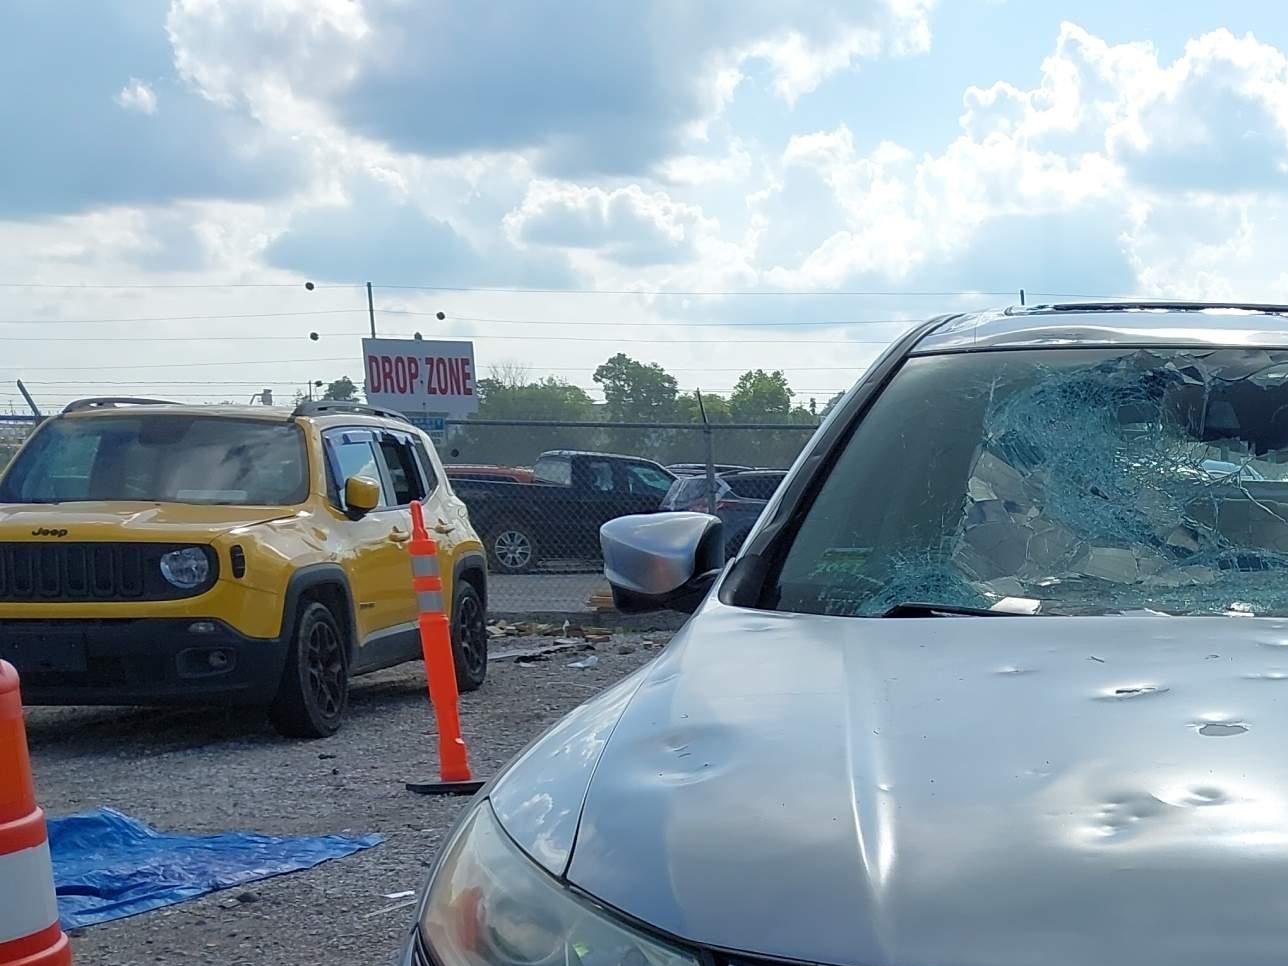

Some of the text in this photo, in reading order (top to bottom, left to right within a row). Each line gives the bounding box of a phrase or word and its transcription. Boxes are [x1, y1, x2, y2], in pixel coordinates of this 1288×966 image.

[368, 356, 473, 395] DROP ZONE
[32, 527, 68, 538] Jeep
